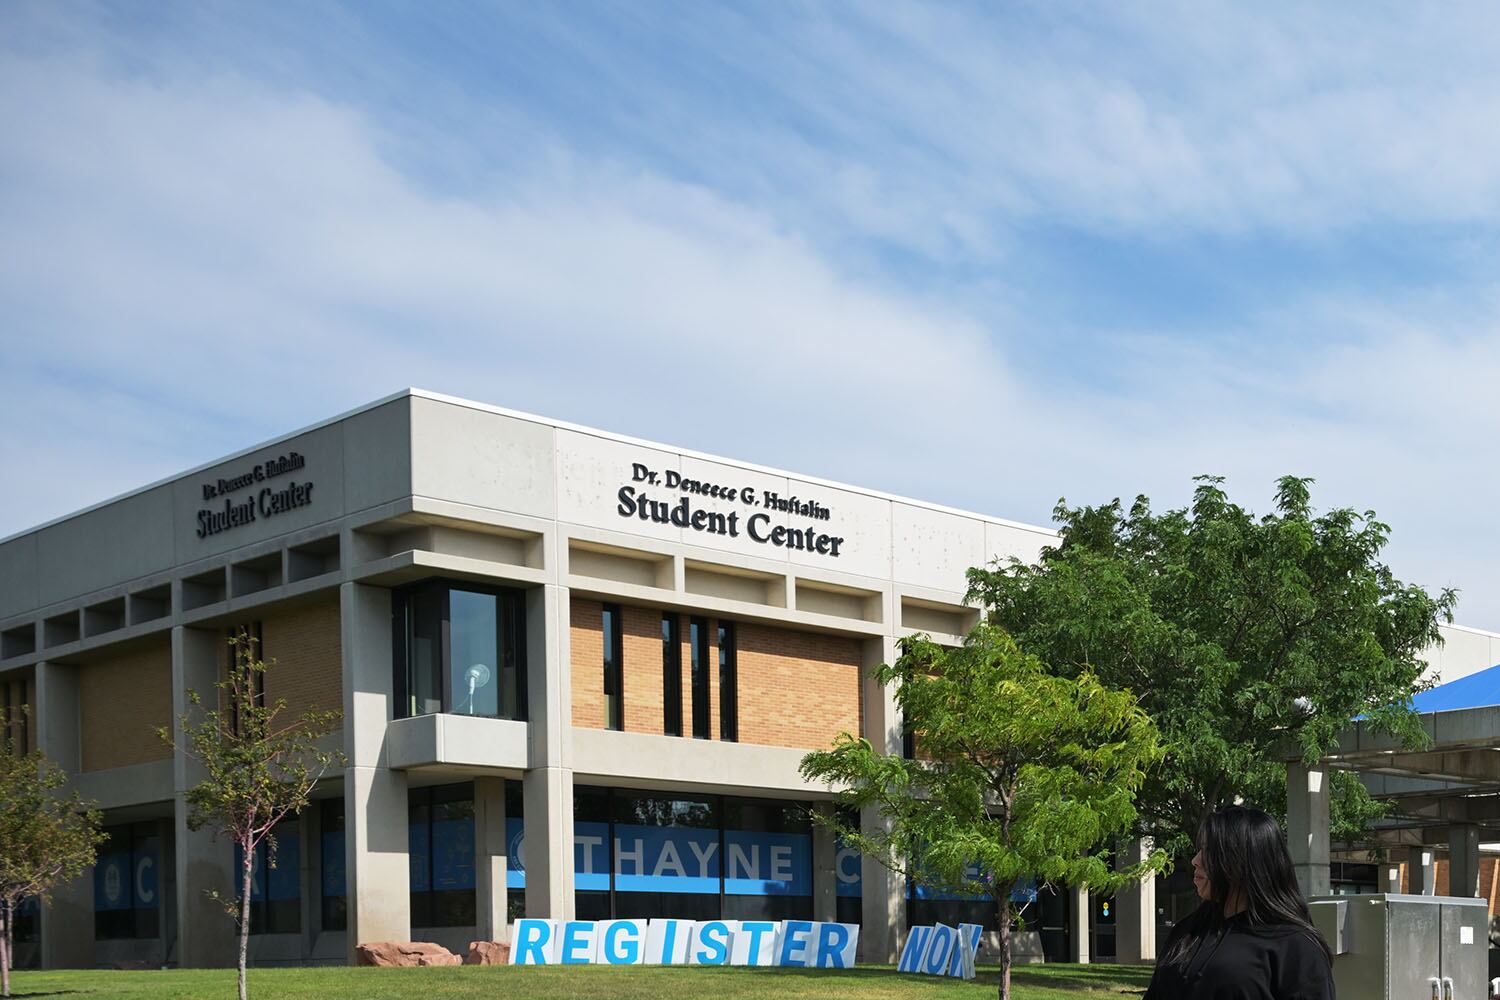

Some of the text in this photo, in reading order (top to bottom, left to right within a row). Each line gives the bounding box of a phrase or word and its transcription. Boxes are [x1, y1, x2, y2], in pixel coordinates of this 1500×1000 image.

[196, 482, 314, 539] Student Center
[632, 463, 831, 521] Dr. Deneece G. Huftalin
[617, 486, 844, 557] Student Center
[573, 836, 793, 881] THAYNE
[514, 919, 850, 968] REGISTER
